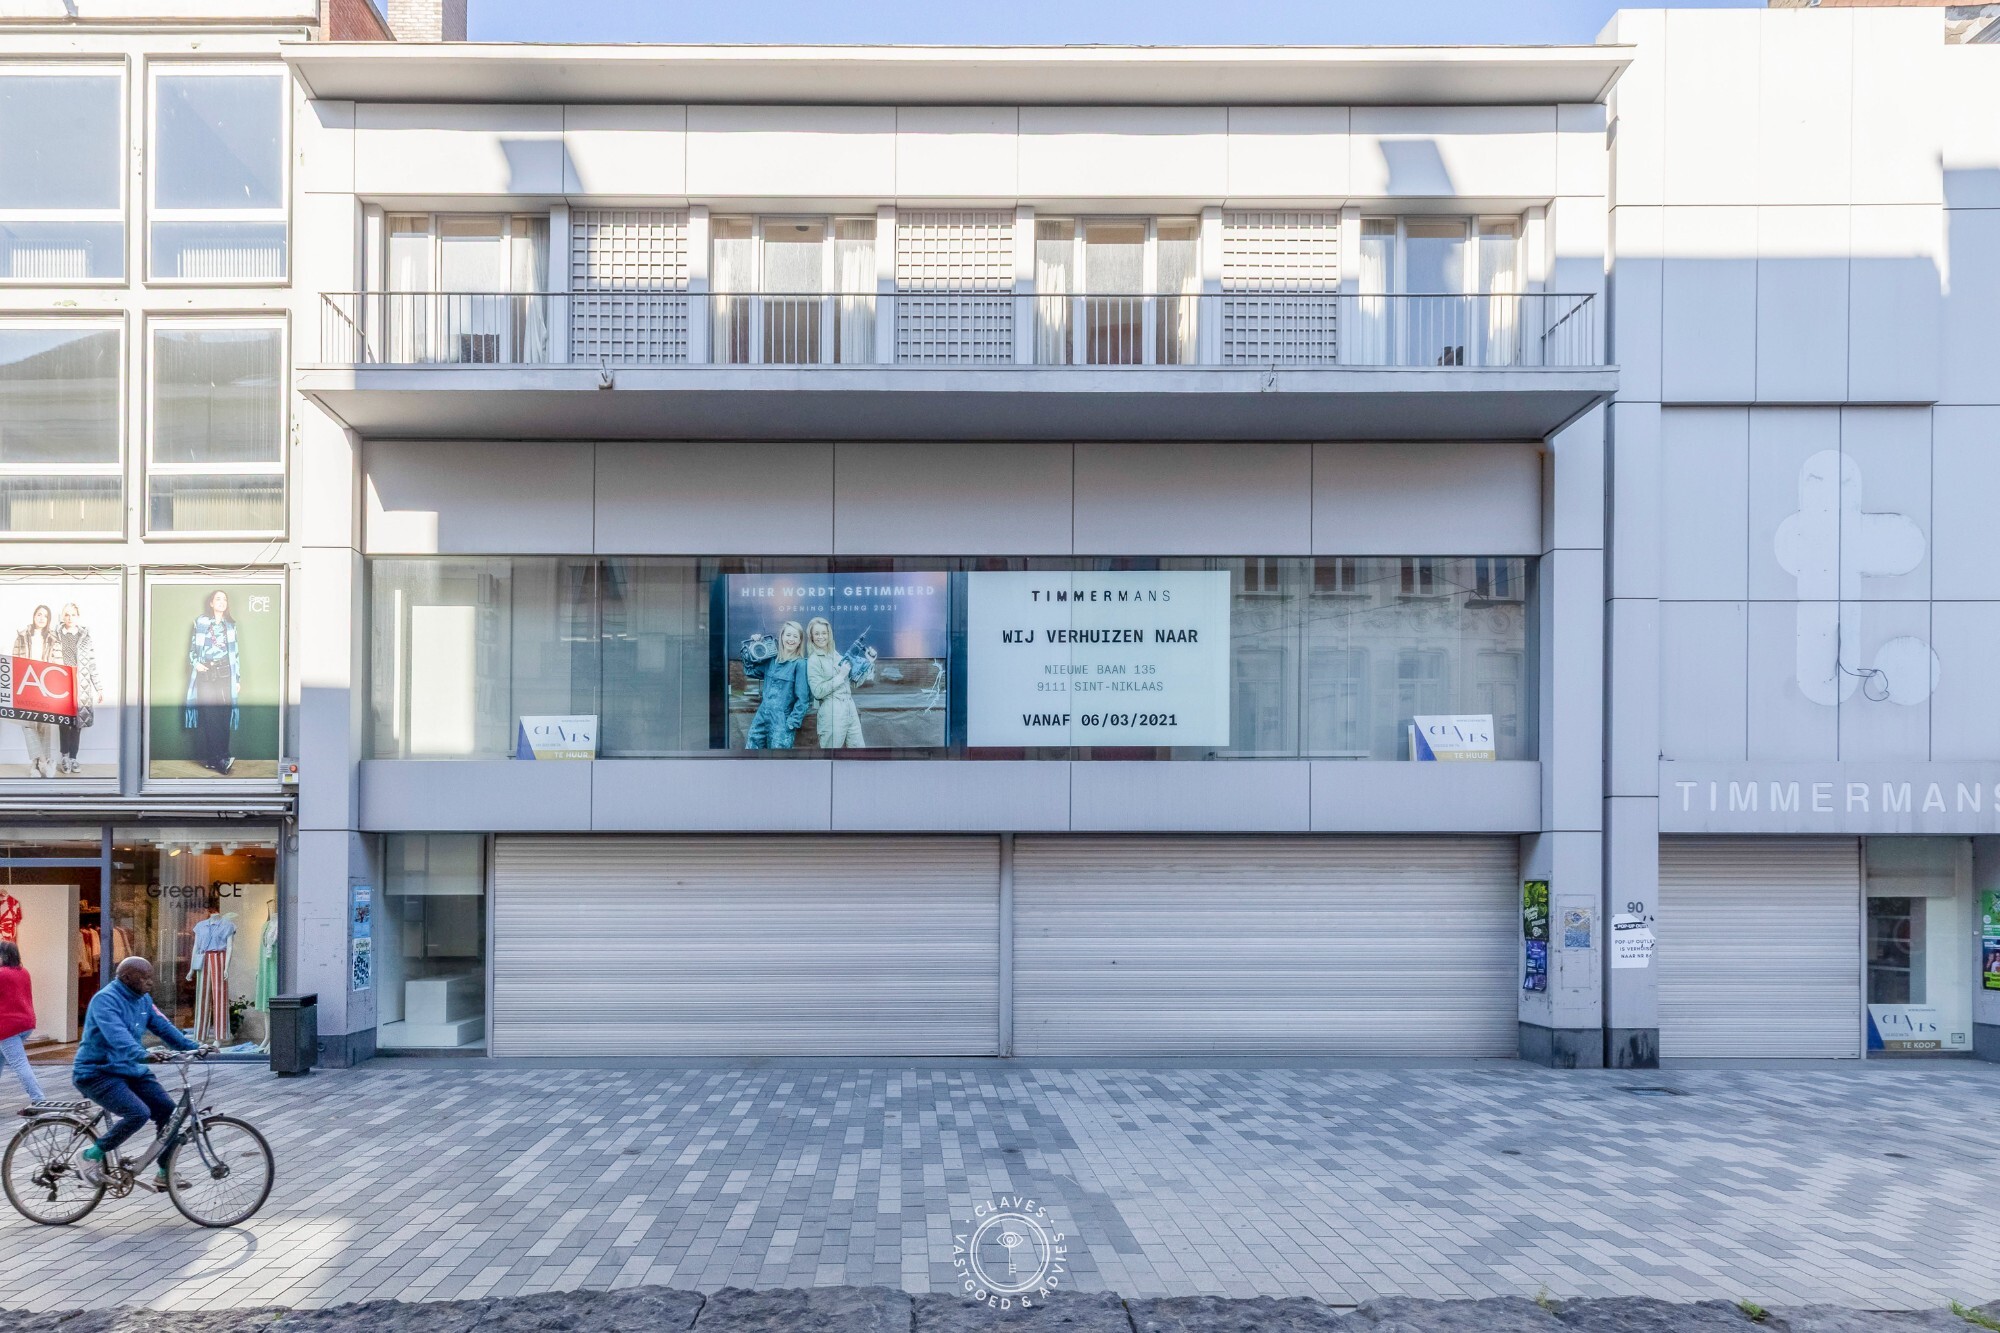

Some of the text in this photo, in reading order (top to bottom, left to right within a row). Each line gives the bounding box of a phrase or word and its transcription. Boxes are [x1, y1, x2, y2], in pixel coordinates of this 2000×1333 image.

[741, 586, 935, 597] HIER WORDT GETIMMERD
[1032, 590, 1171, 602] TIMMERMANS
[249, 600, 270, 612] ICE
[1002, 629, 1199, 643] WIJ VERHUIZEN NAAR
[1044, 664, 1156, 675] NIEUWE BAAN 135
[0, 657, 11, 704] TE KOOP
[16, 664, 70, 699] AC
[1037, 681, 1164, 692] 9111 SINT-NIKLAAS
[0, 708, 71, 725] 03 777 93 93
[1022, 713, 1178, 727] VANAF 06/03/2021
[1674, 780, 2000, 813] TIMMERMAN
[146, 881, 206, 898] Green
[1627, 901, 1644, 913] 90
